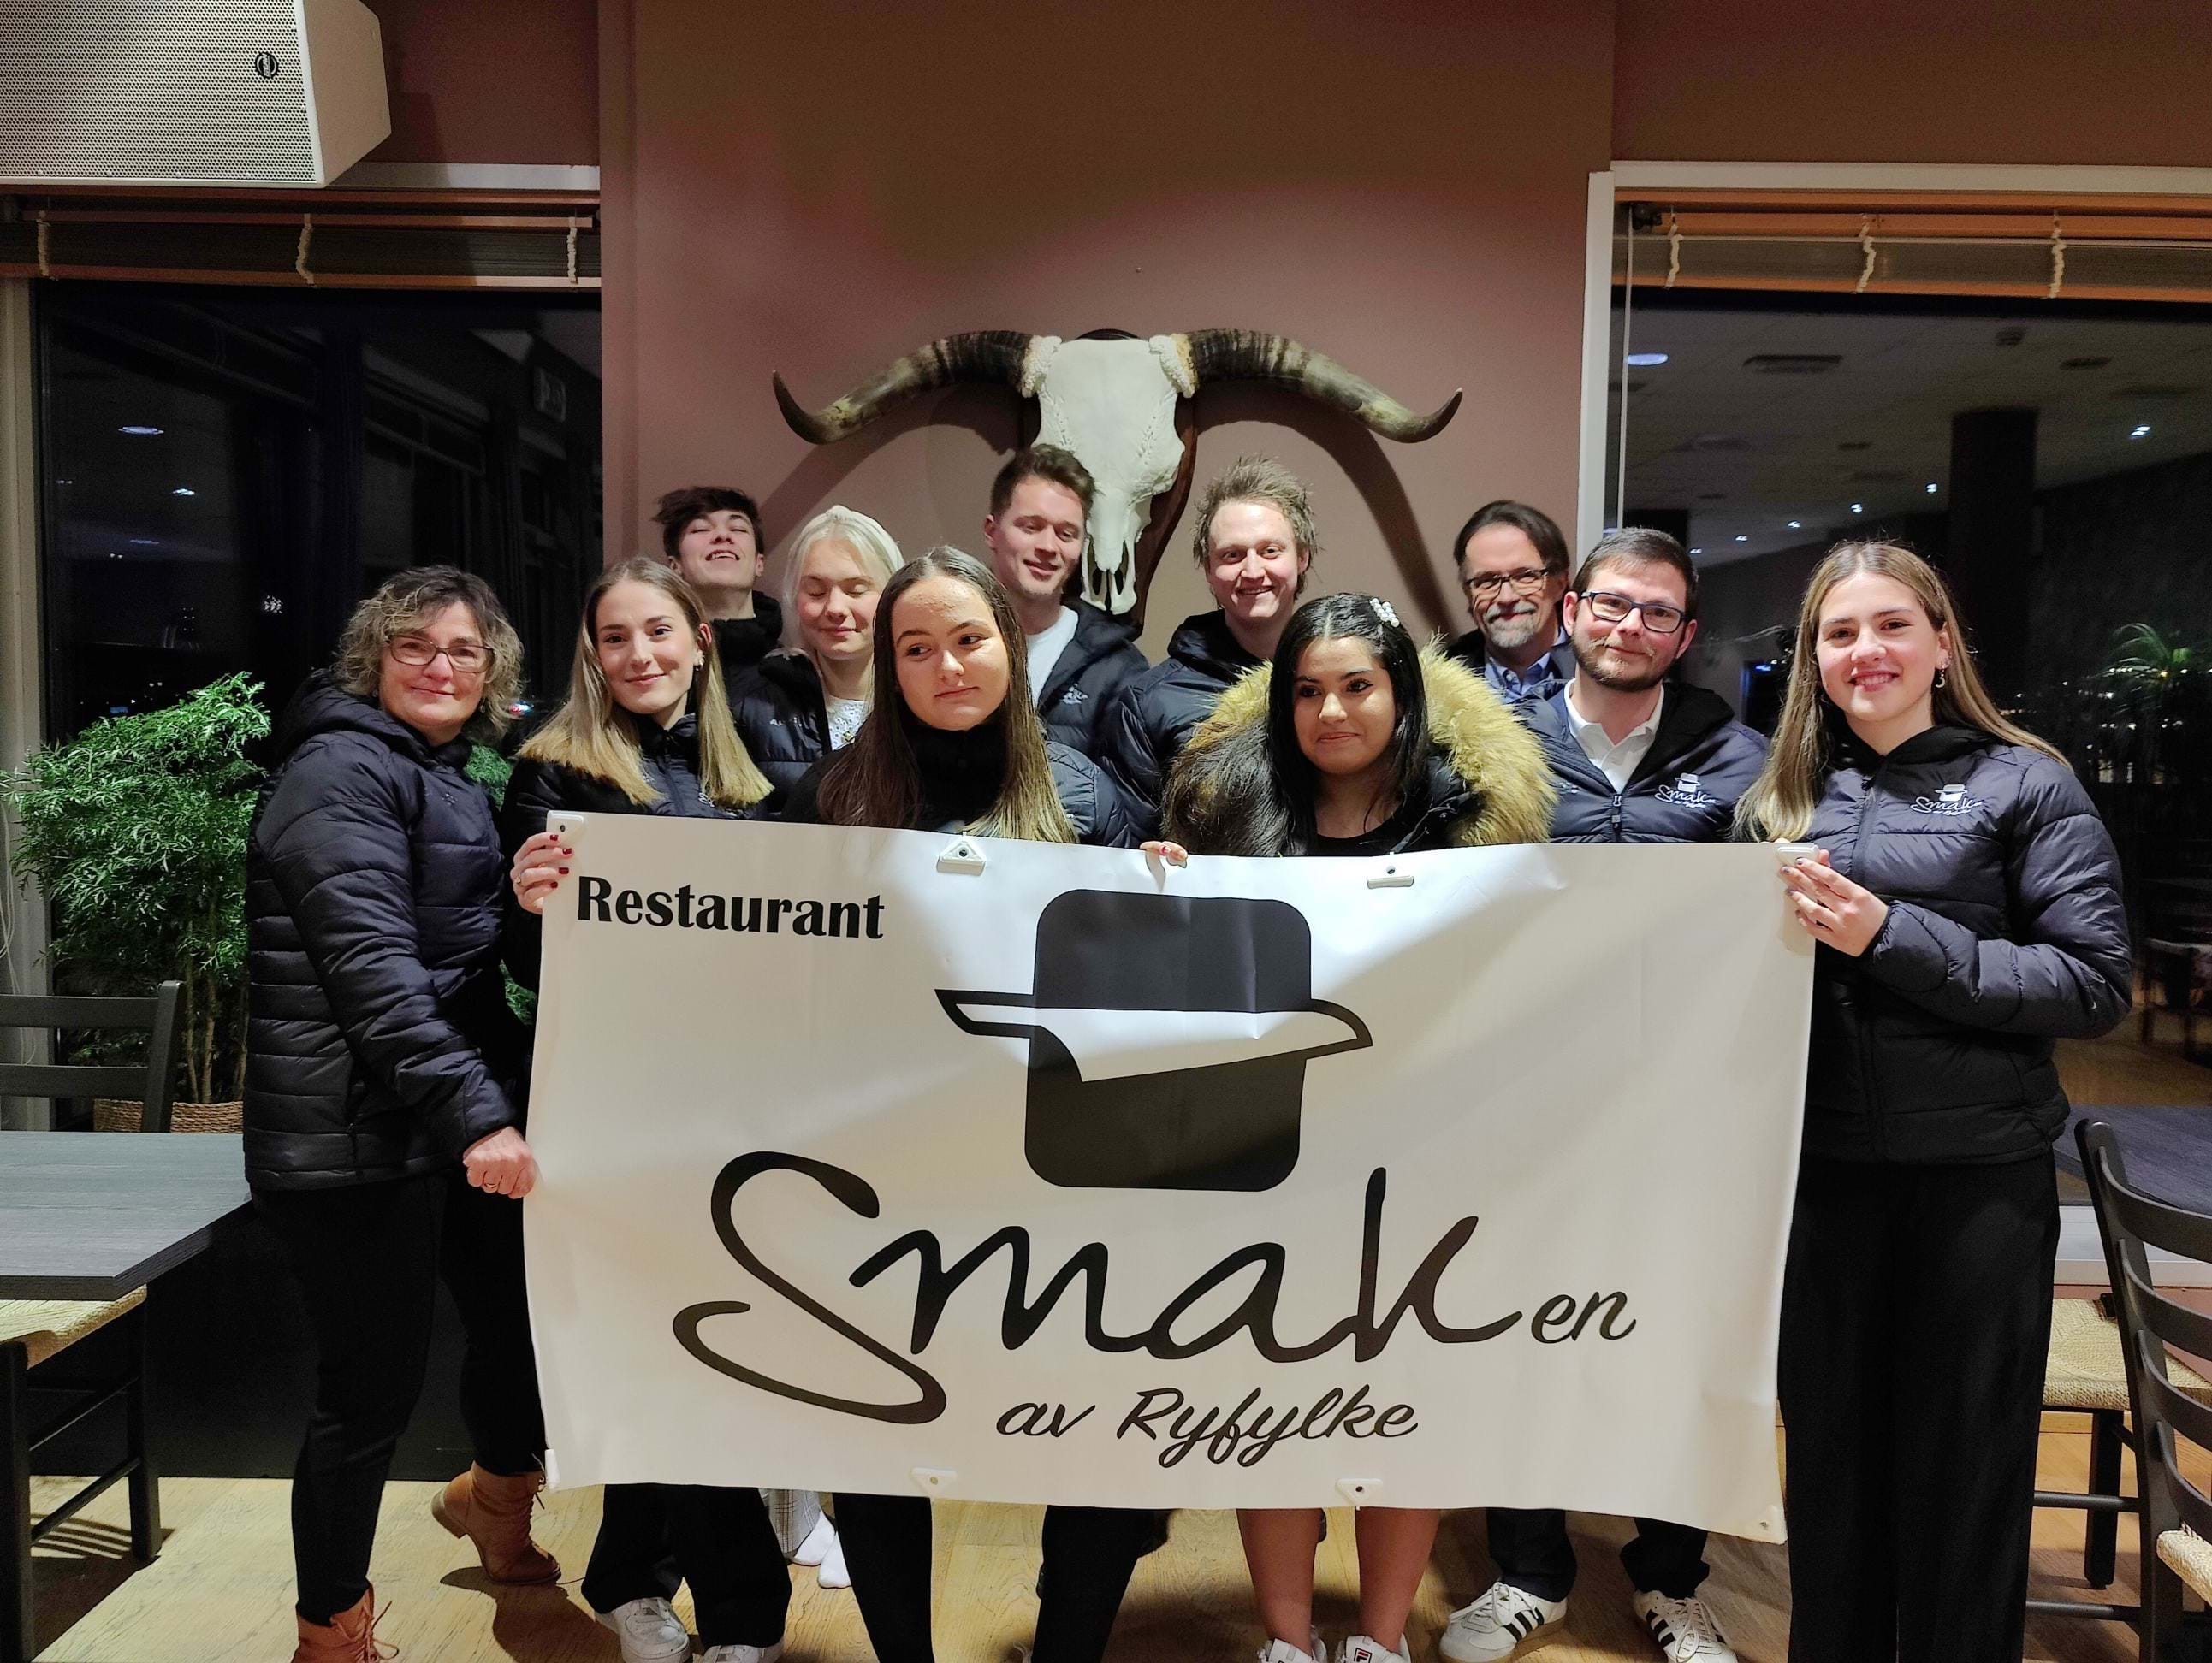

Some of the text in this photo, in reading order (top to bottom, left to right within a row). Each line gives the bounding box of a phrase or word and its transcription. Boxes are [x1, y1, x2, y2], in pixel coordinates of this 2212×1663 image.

[578, 875, 885, 939] Restaurant
[996, 1384, 1419, 1469] av Ryfylke
